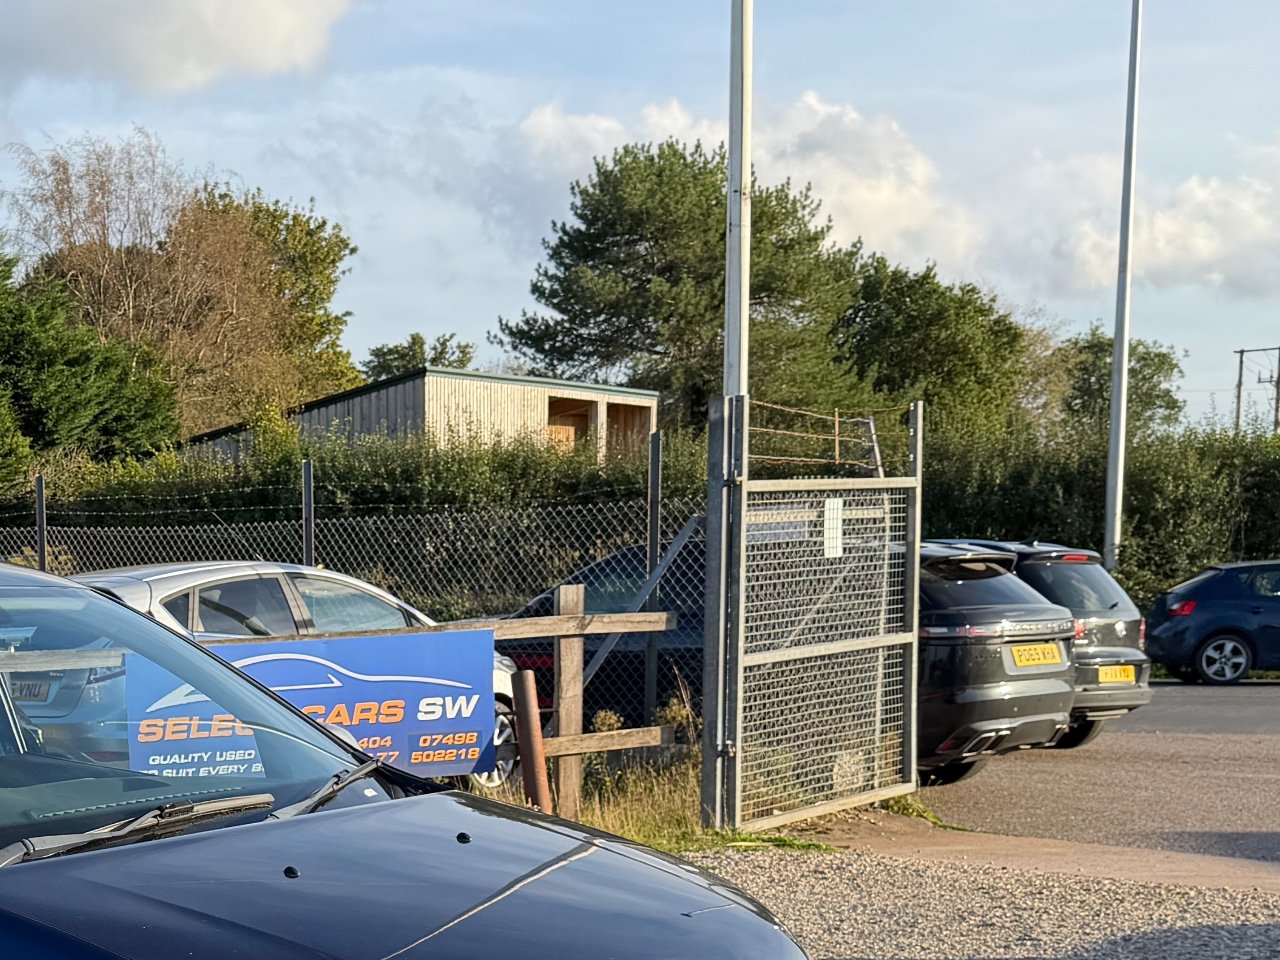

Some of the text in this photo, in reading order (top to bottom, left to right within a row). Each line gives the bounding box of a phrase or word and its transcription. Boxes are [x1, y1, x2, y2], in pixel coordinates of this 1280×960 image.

[137, 714, 255, 743] SELEC
[417, 694, 480, 721] SW
[358, 733, 478, 749] 404 07498
[148, 749, 256, 765] QUALITY USED
[410, 748, 480, 763] 502218
[199, 764, 248, 777] EVERY
